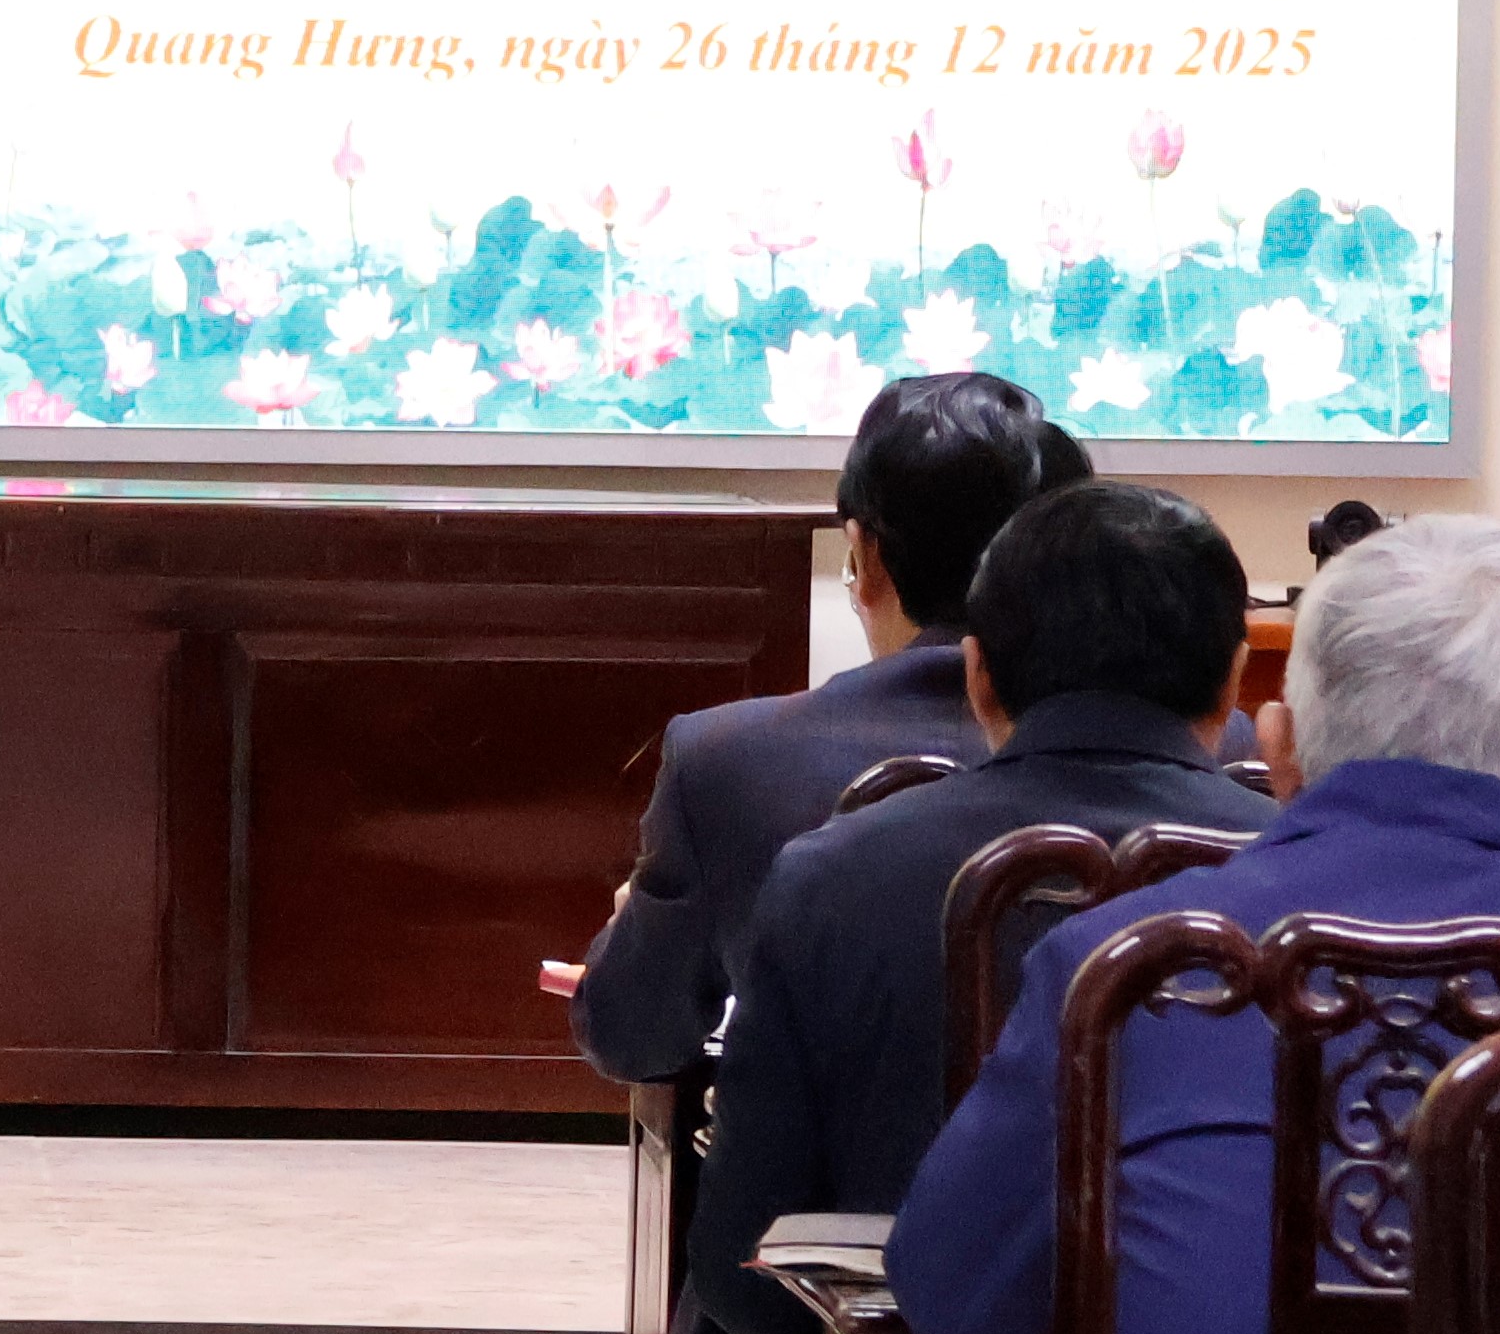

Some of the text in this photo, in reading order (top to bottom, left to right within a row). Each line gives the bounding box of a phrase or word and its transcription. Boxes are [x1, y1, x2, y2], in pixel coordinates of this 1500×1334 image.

[73, 15, 1317, 87] Quang Hưng, ngày 26 tháng 12 năm 2025
